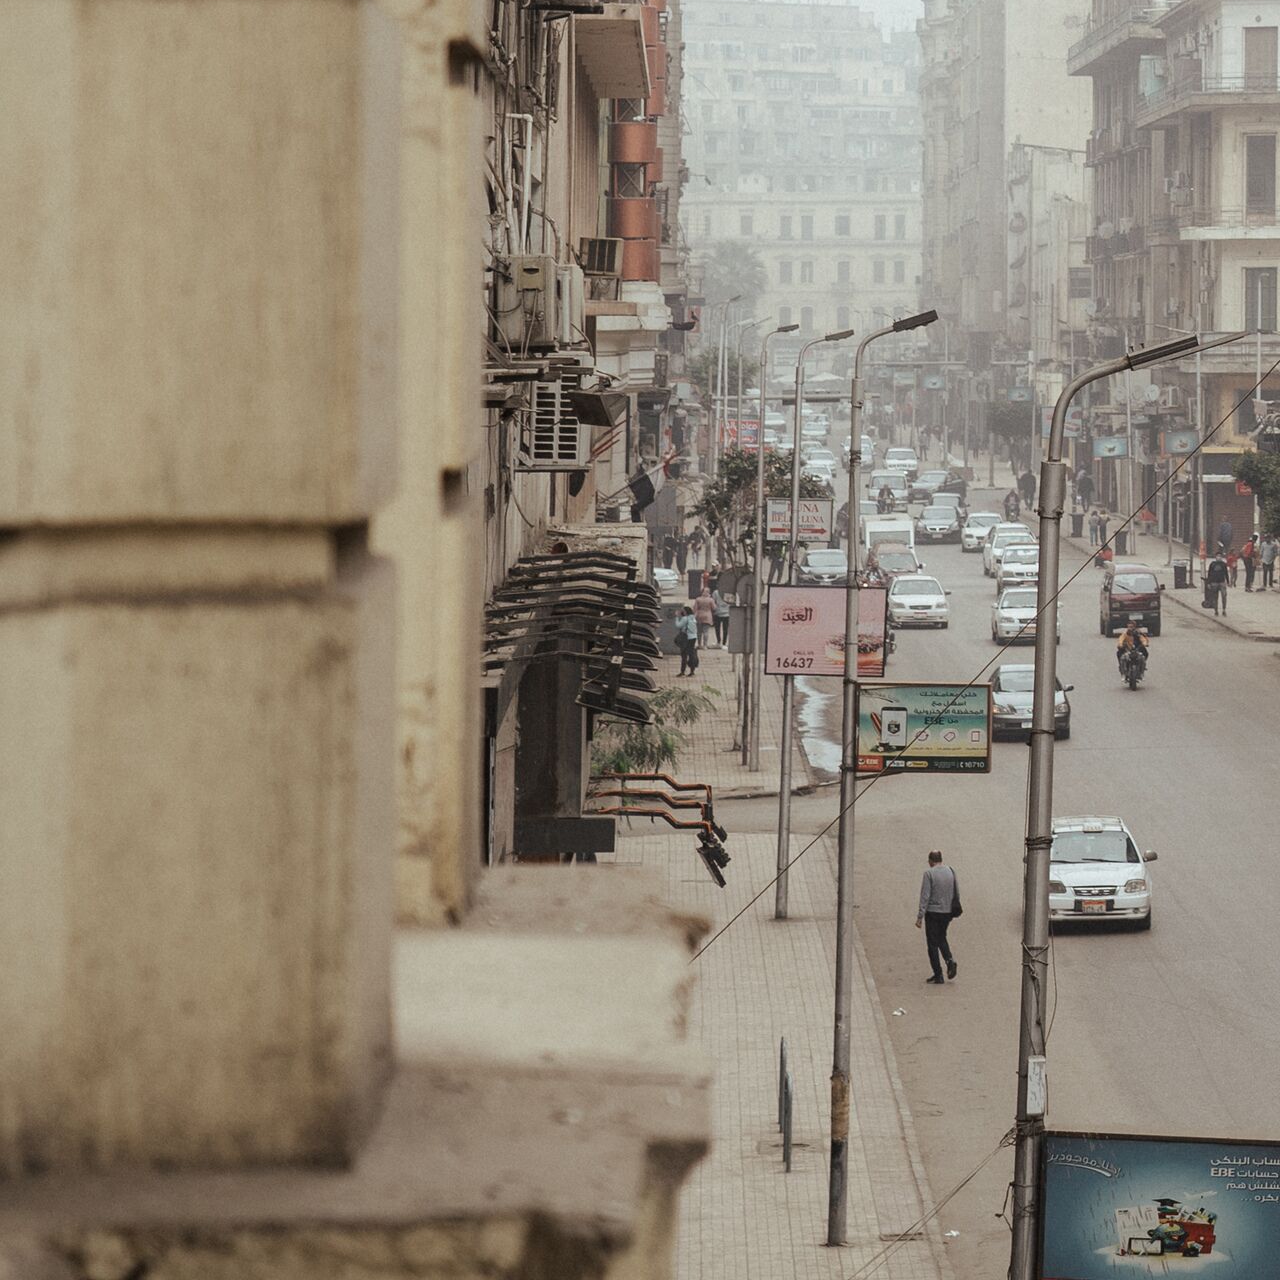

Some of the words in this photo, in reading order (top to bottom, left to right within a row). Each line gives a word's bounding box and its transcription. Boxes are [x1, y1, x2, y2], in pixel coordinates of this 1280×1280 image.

[781, 607, 813, 624] العبد
[776, 657, 814, 669] 16437
[1210, 1168, 1235, 1177] EBE
[1237, 1170, 1279, 1179] حسابات
